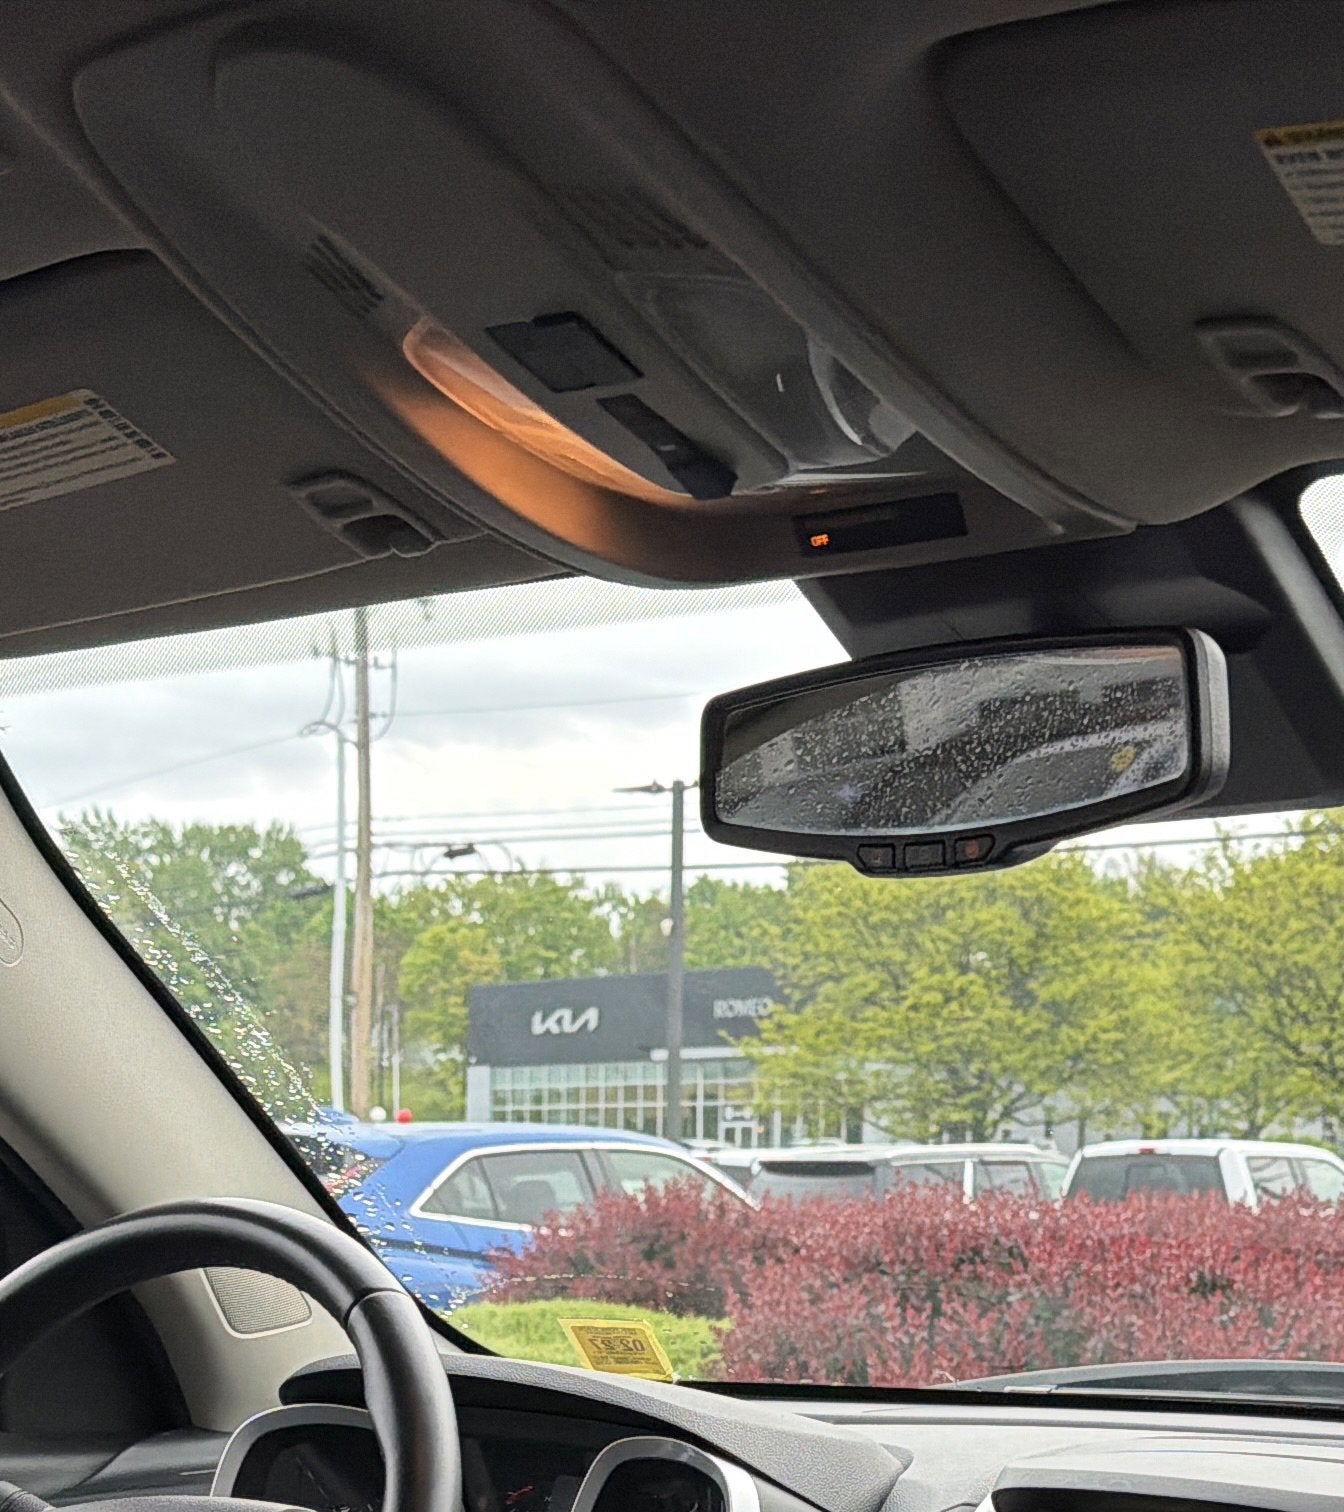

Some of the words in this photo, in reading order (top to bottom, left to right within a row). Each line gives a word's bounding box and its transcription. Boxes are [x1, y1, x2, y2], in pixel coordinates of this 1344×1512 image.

[809, 533, 830, 548] OFF
[712, 996, 774, 1018] ROMEO
[531, 1006, 600, 1036] KIA
